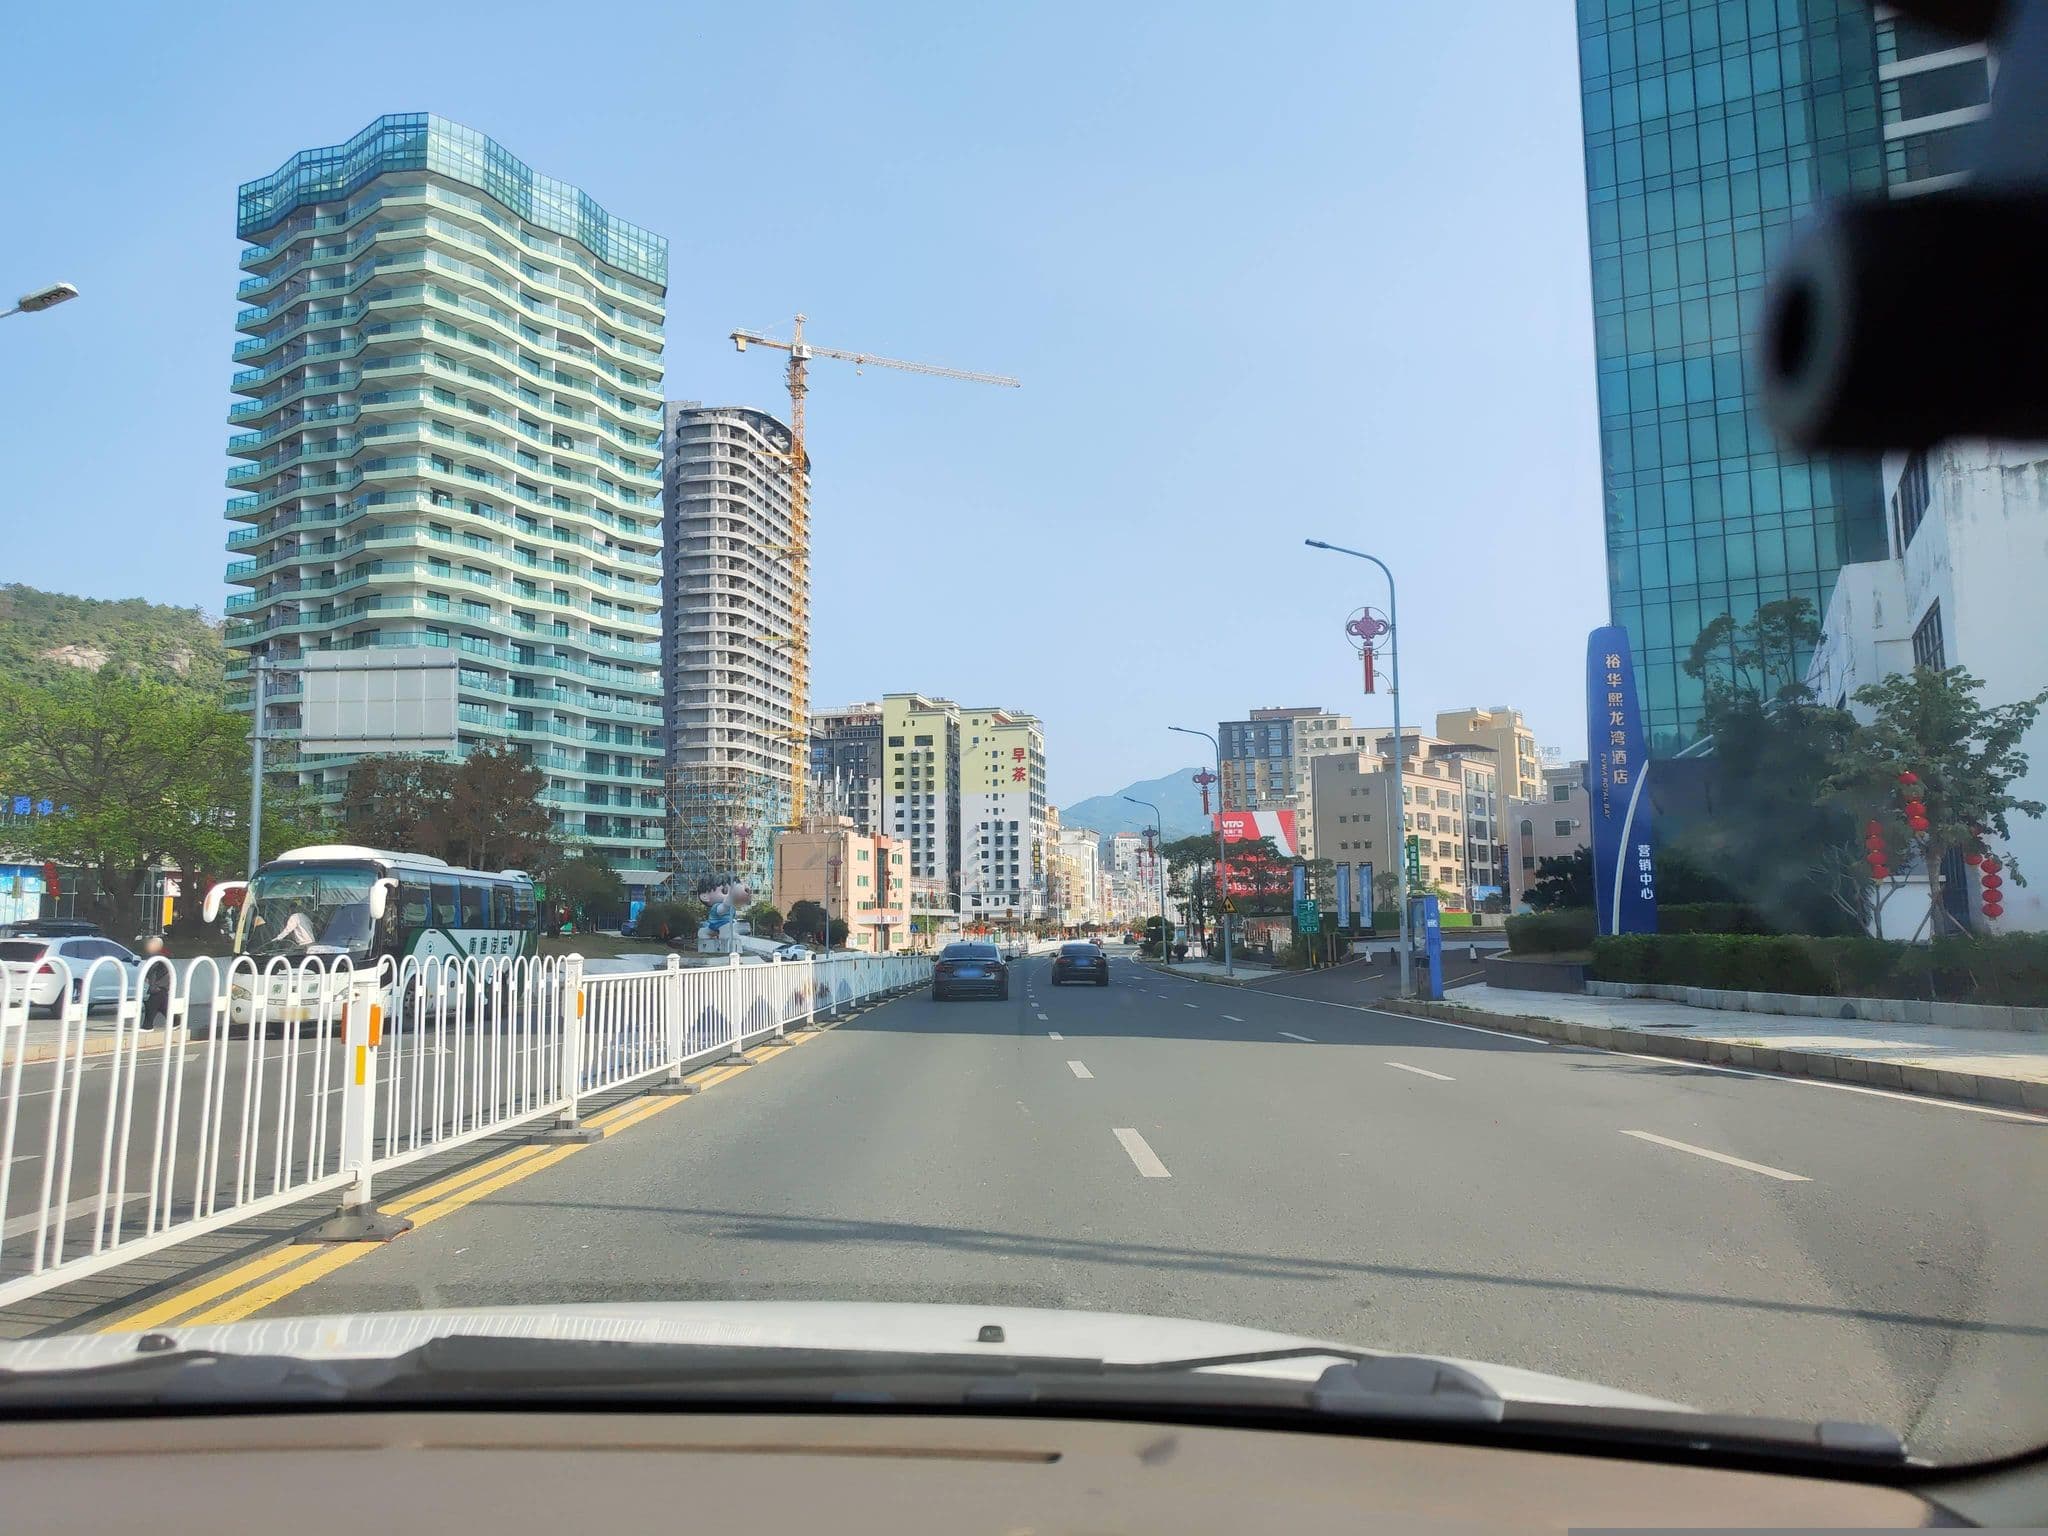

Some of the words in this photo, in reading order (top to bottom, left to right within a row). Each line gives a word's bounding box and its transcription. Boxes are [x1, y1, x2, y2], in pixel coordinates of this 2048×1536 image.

[1605, 653, 1628, 785] 裕华熙龙湾酒店
[1012, 747, 1026, 782] 早茶
[1638, 844, 1654, 900] 营销中心
